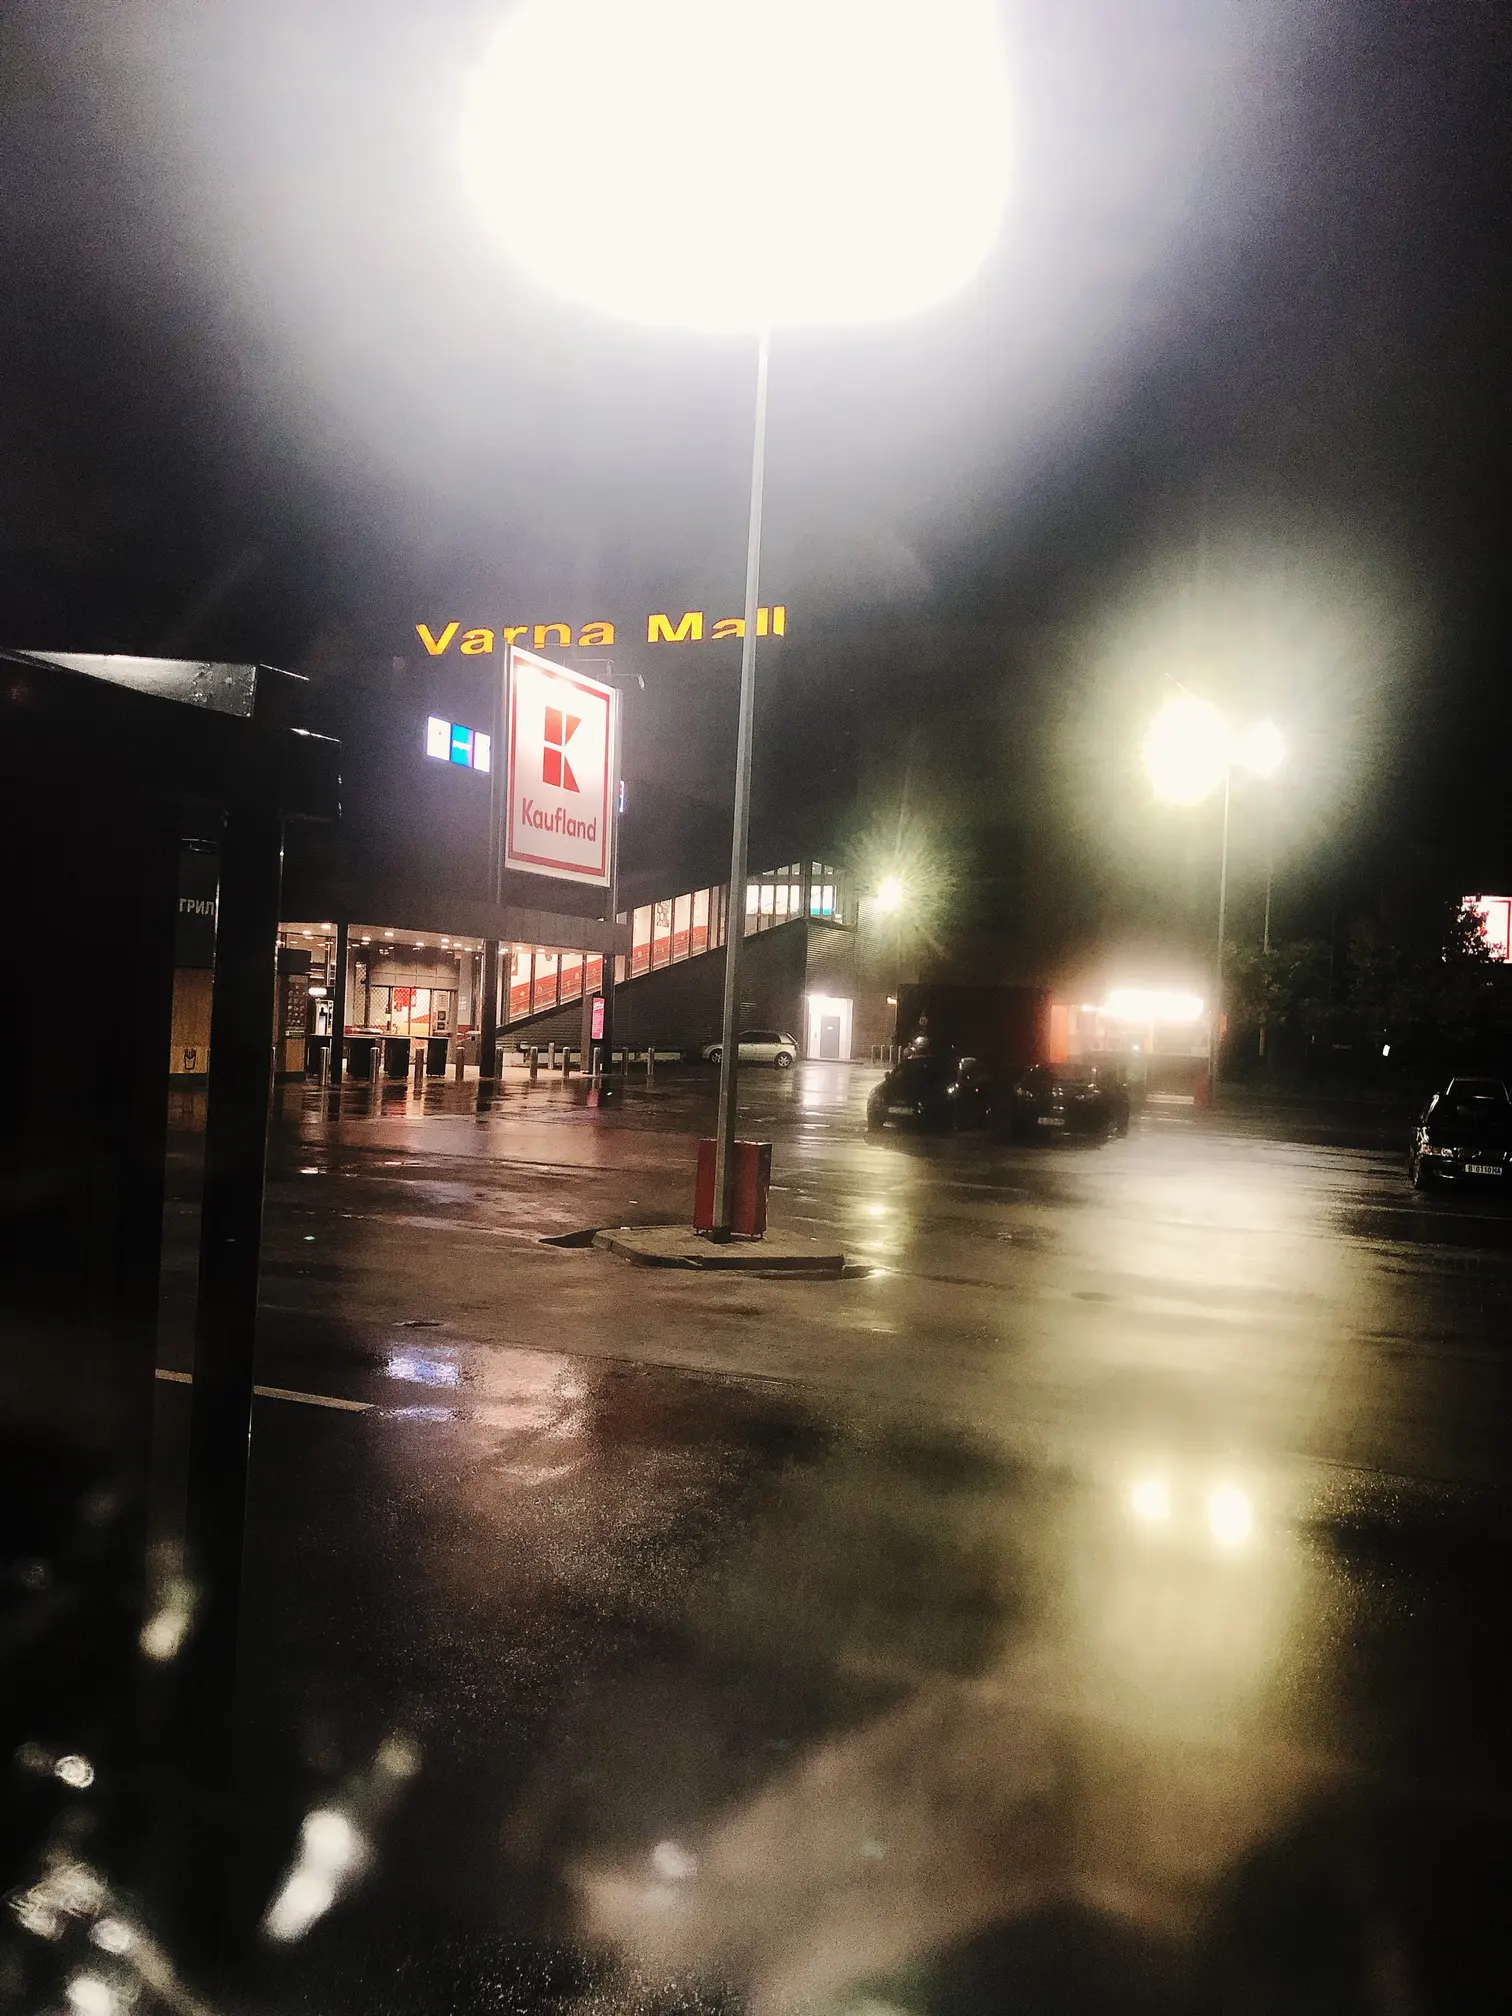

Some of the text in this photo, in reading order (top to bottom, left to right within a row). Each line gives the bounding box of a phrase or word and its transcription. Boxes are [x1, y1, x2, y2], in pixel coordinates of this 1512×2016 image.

[415, 605, 786, 656] Varna Mall
[521, 797, 597, 842] Kaufland
